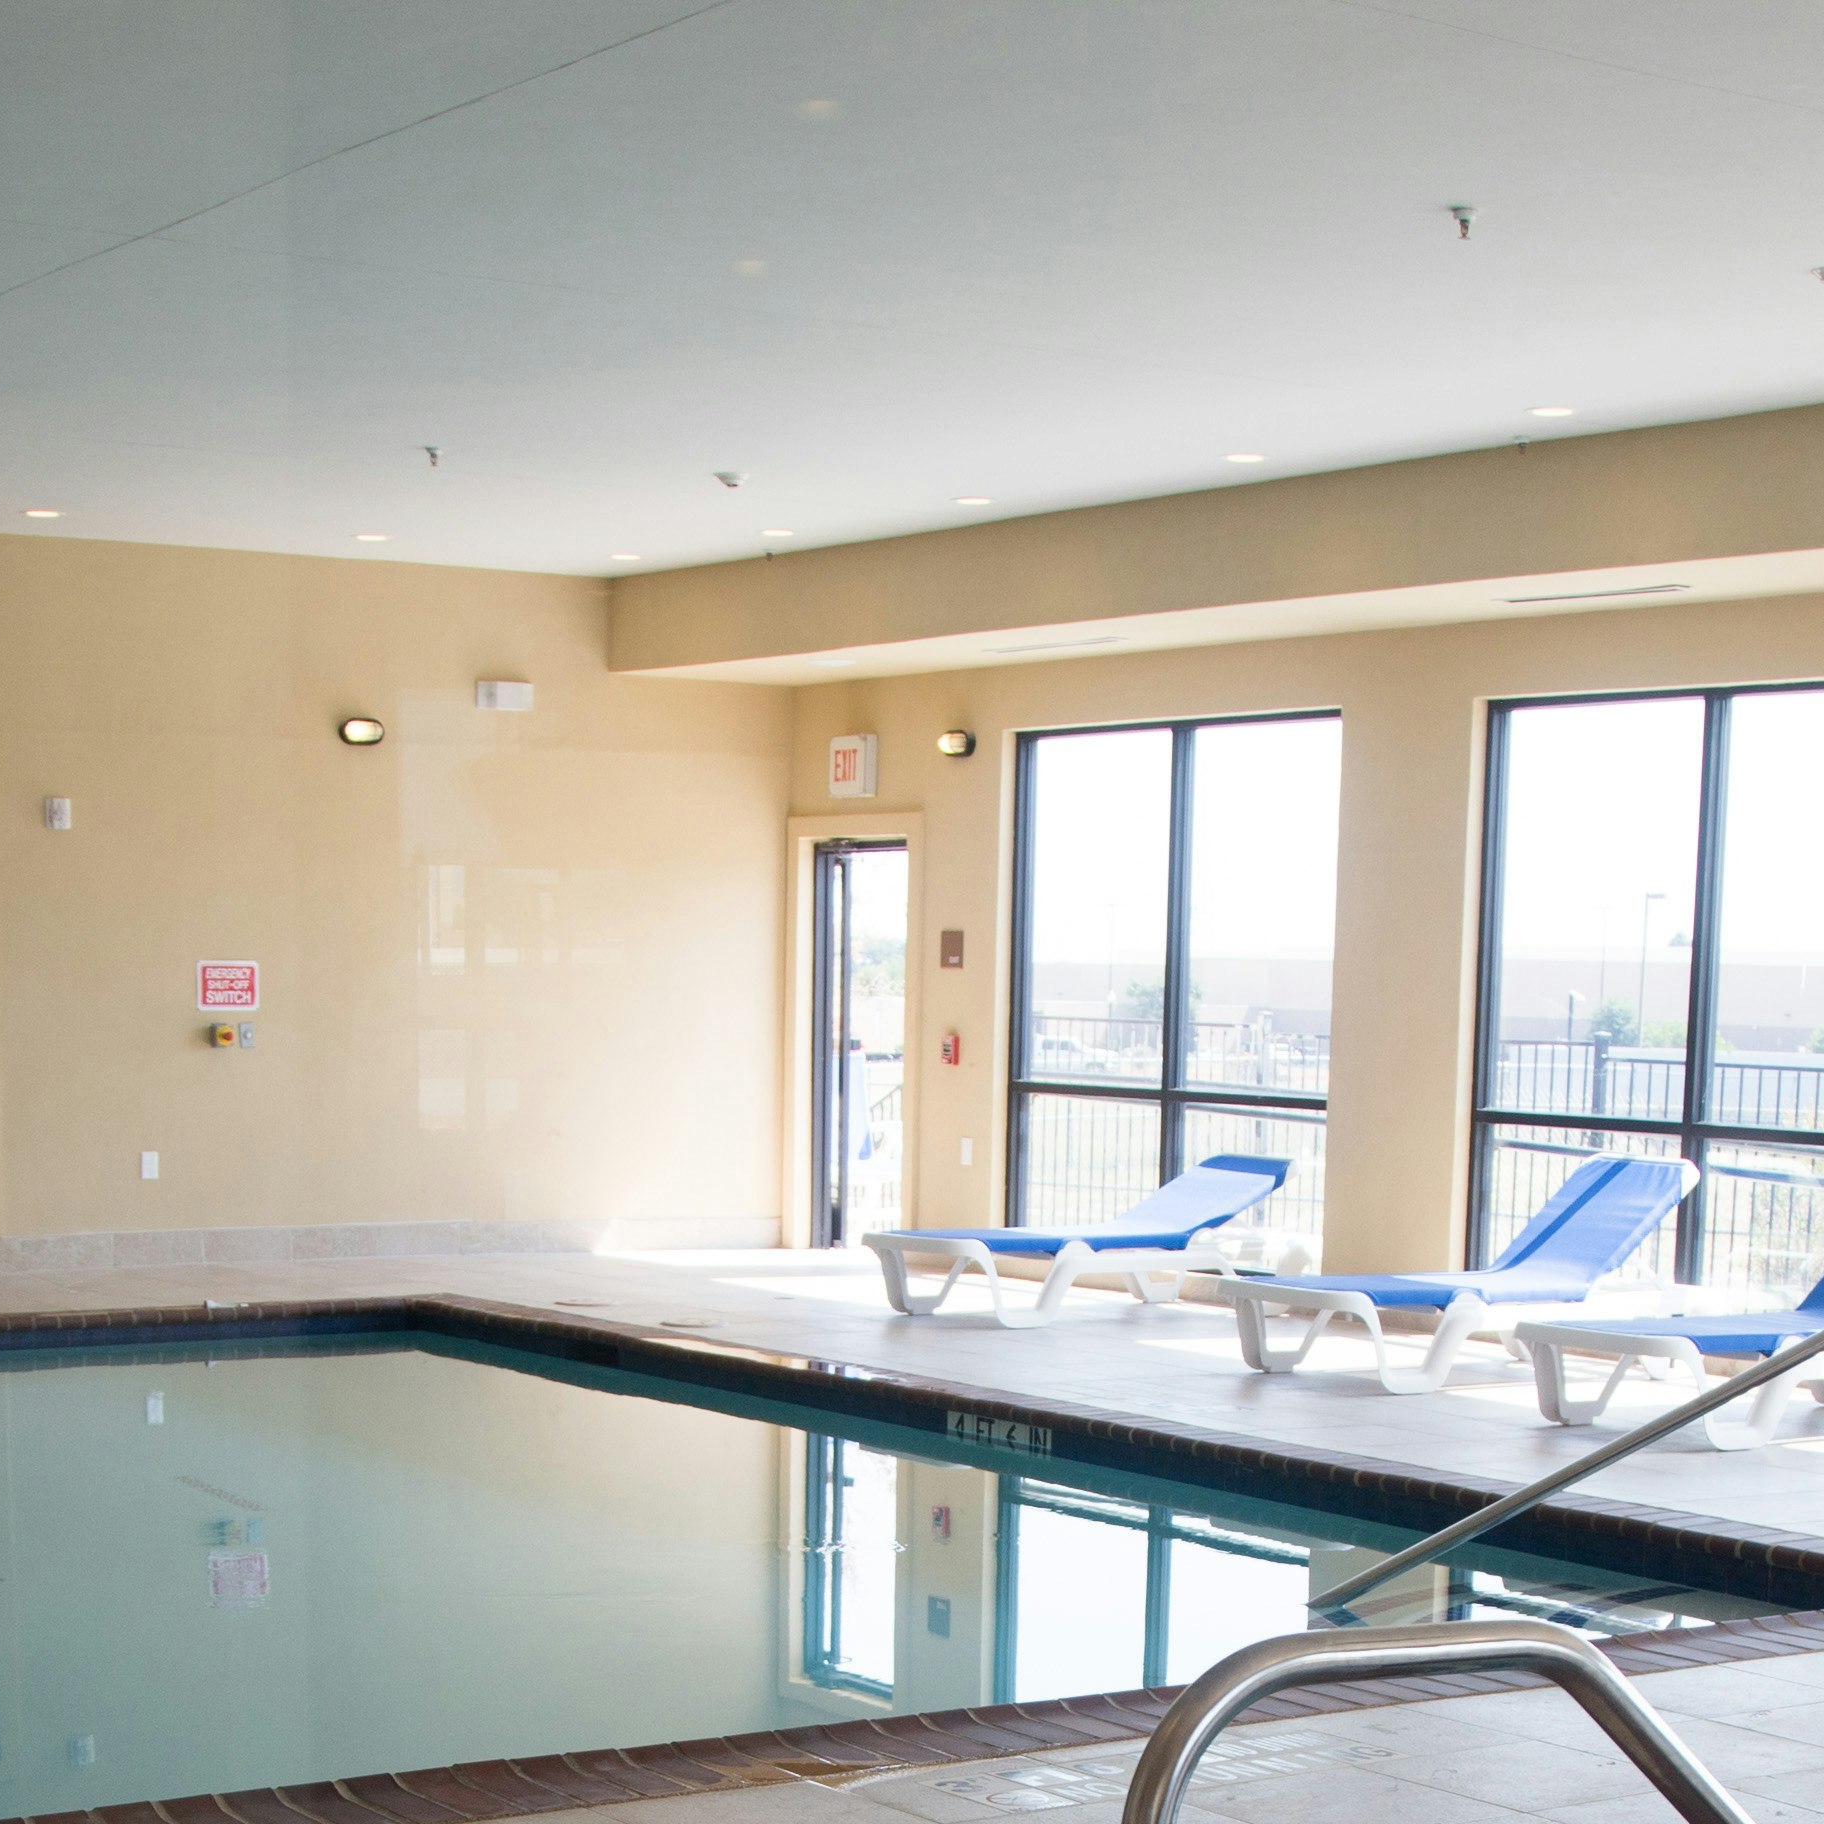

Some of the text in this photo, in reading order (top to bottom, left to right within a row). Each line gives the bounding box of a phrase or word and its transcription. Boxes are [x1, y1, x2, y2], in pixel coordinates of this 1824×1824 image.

[834, 749, 858, 782] EXIT
[206, 967, 251, 980] EMERGENCY
[207, 979, 249, 990] SHUT-OFF
[206, 990, 252, 1004] SWITCH
[976, 1417, 995, 1442] FT
[1052, 1782, 1129, 1799] NO
